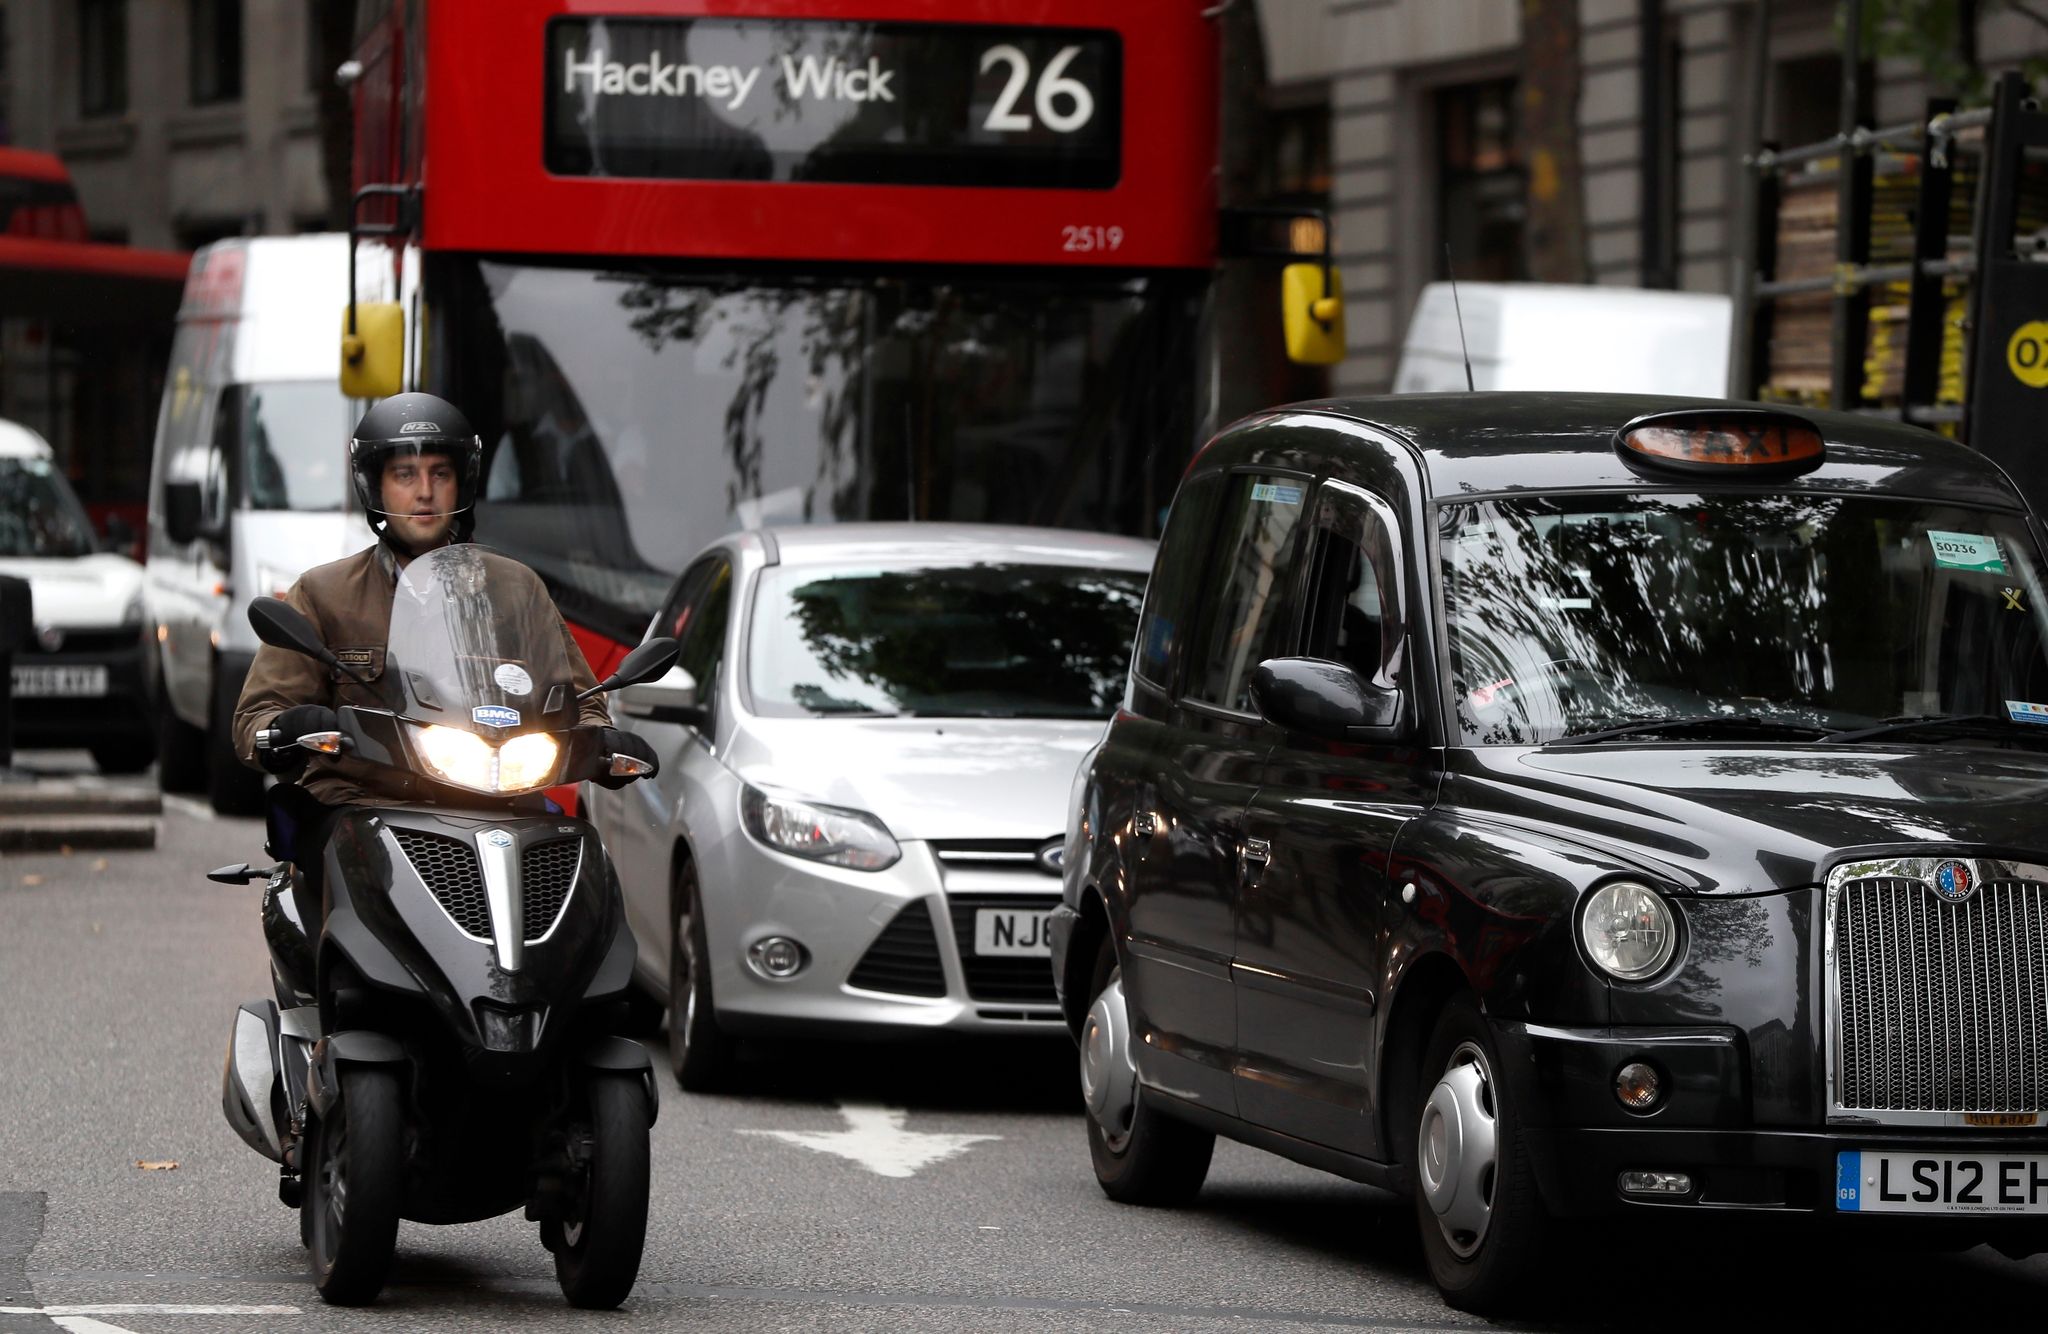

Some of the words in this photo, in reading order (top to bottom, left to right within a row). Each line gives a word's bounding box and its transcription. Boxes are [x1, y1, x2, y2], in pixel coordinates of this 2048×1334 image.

[565, 48, 761, 111] Hackney
[782, 54, 896, 102] Wick
[979, 43, 1095, 134] 26
[1061, 225, 1125, 252] 2519
[2015, 336, 2048, 369] 0
[1674, 424, 1790, 457] TAXI
[1936, 542, 1977, 554] 50236
[476, 708, 518, 721] BMG
[1840, 1188, 1857, 1200] GB
[1879, 1158, 1984, 1204] LS12
